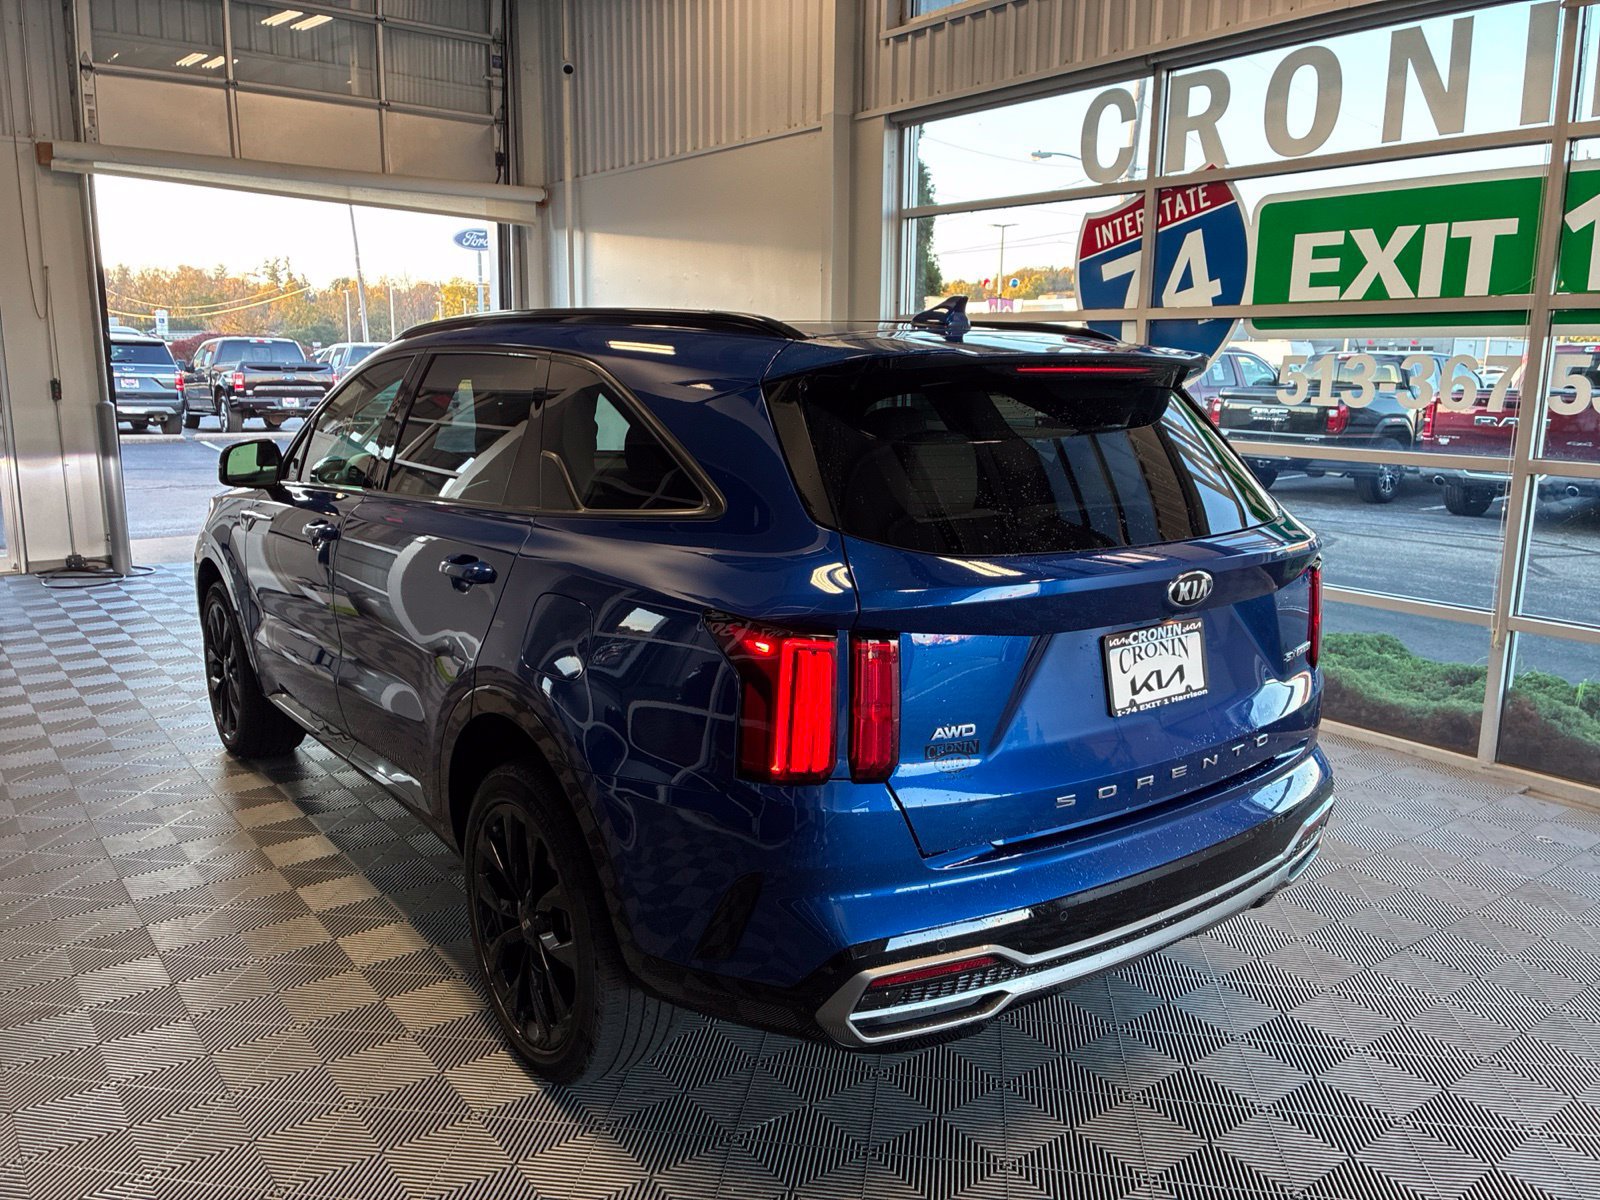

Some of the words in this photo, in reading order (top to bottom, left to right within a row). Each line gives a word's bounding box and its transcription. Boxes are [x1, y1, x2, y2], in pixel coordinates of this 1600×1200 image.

[1080, 2, 1600, 184] CRONI
[1095, 184, 1212, 249] INTERTATE
[1288, 217, 1519, 303] EXIT
[1101, 228, 1223, 343] 74
[1177, 577, 1209, 602] KIA
[1129, 622, 1182, 645] CRONIN
[1119, 635, 1190, 675] CRONIN
[1129, 663, 1186, 697] KIA
[1116, 706, 1138, 717] I-74
[1139, 700, 1161, 711] EXIT
[1171, 688, 1208, 703] Harrison
[930, 723, 976, 741] AWD
[1055, 733, 1270, 810] SORENTO
